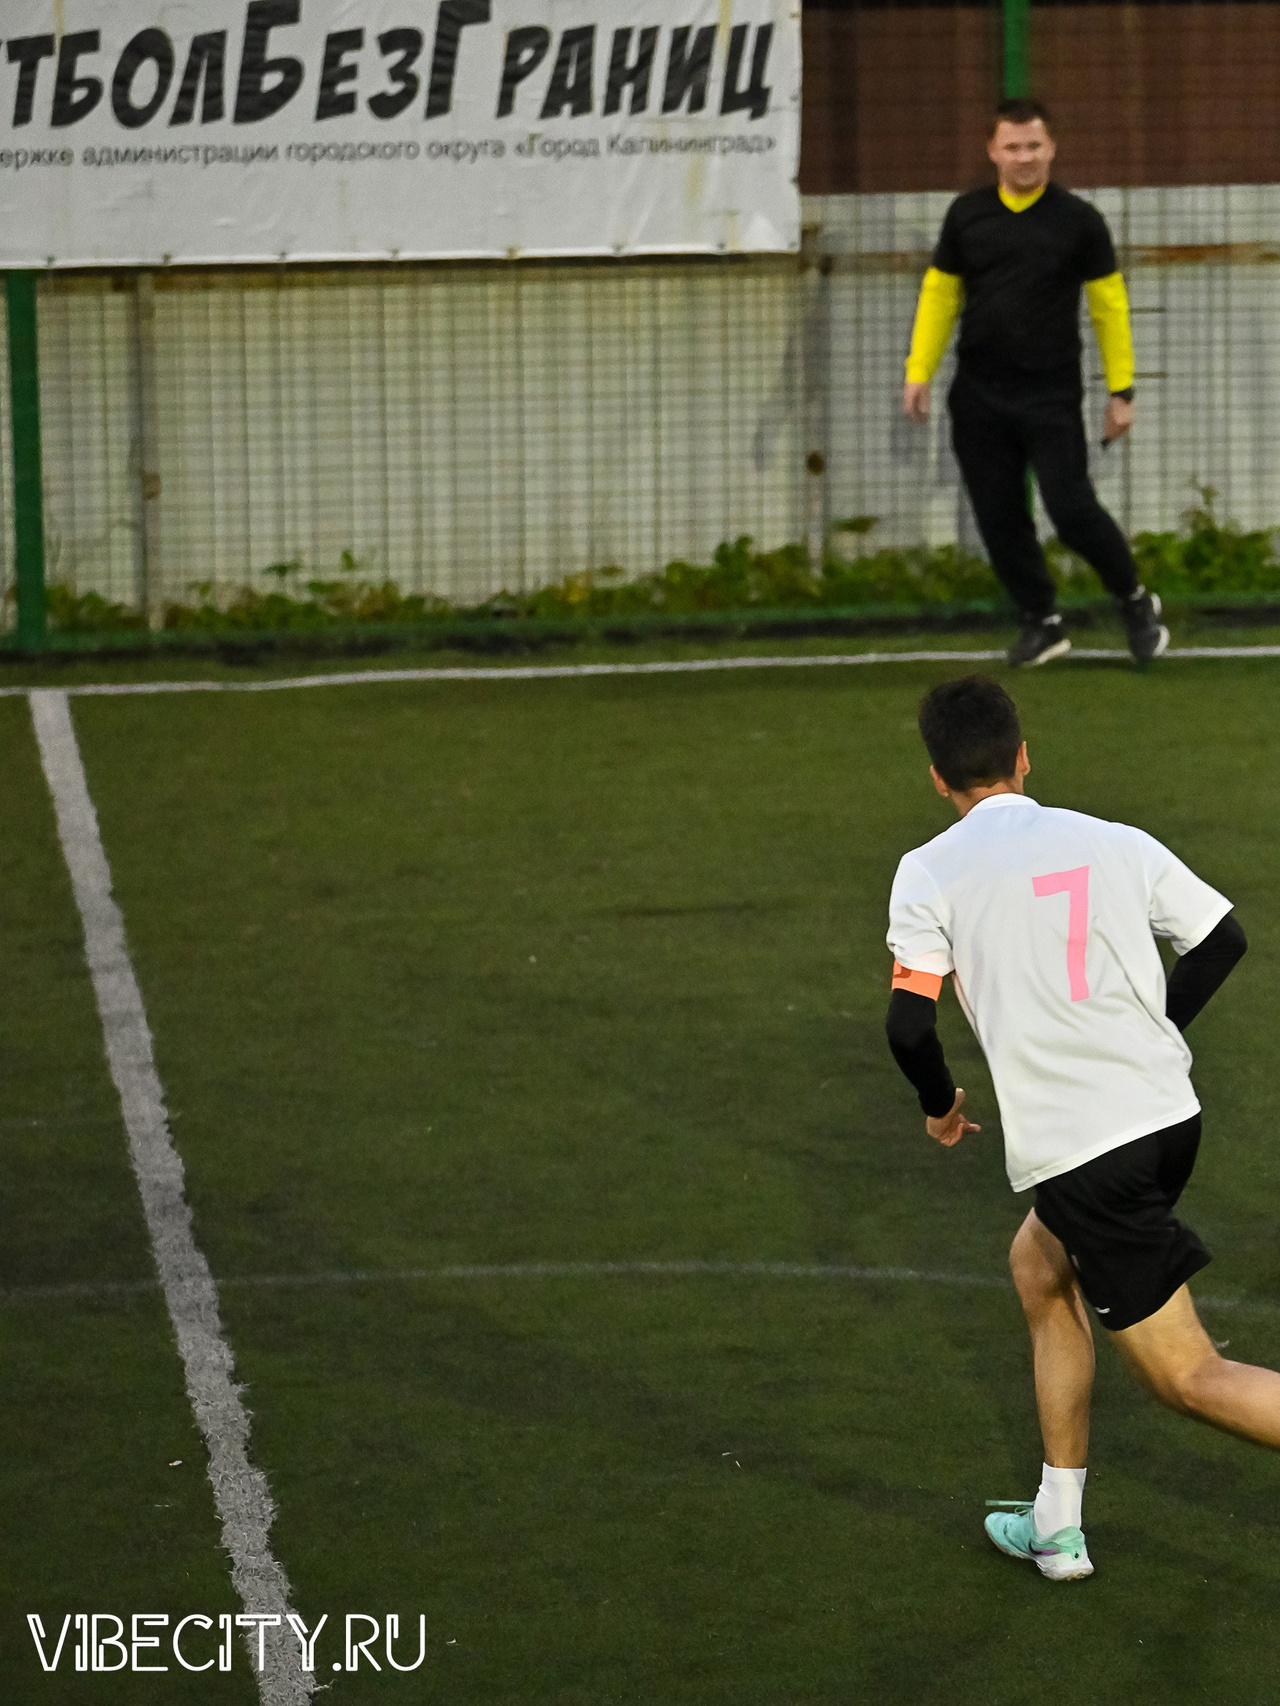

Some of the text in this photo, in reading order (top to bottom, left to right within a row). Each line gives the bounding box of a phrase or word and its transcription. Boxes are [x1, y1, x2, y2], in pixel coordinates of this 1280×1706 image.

[0, 0, 776, 129] ТБОЛБЕЗГРАНИЦ
[82, 143, 279, 168] администрации
[285, 140, 420, 164] городского
[428, 138, 506, 164] округа
[514, 132, 600, 161] «Город
[607, 133, 777, 157] Калининград»
[1032, 865, 1090, 1003] 7
